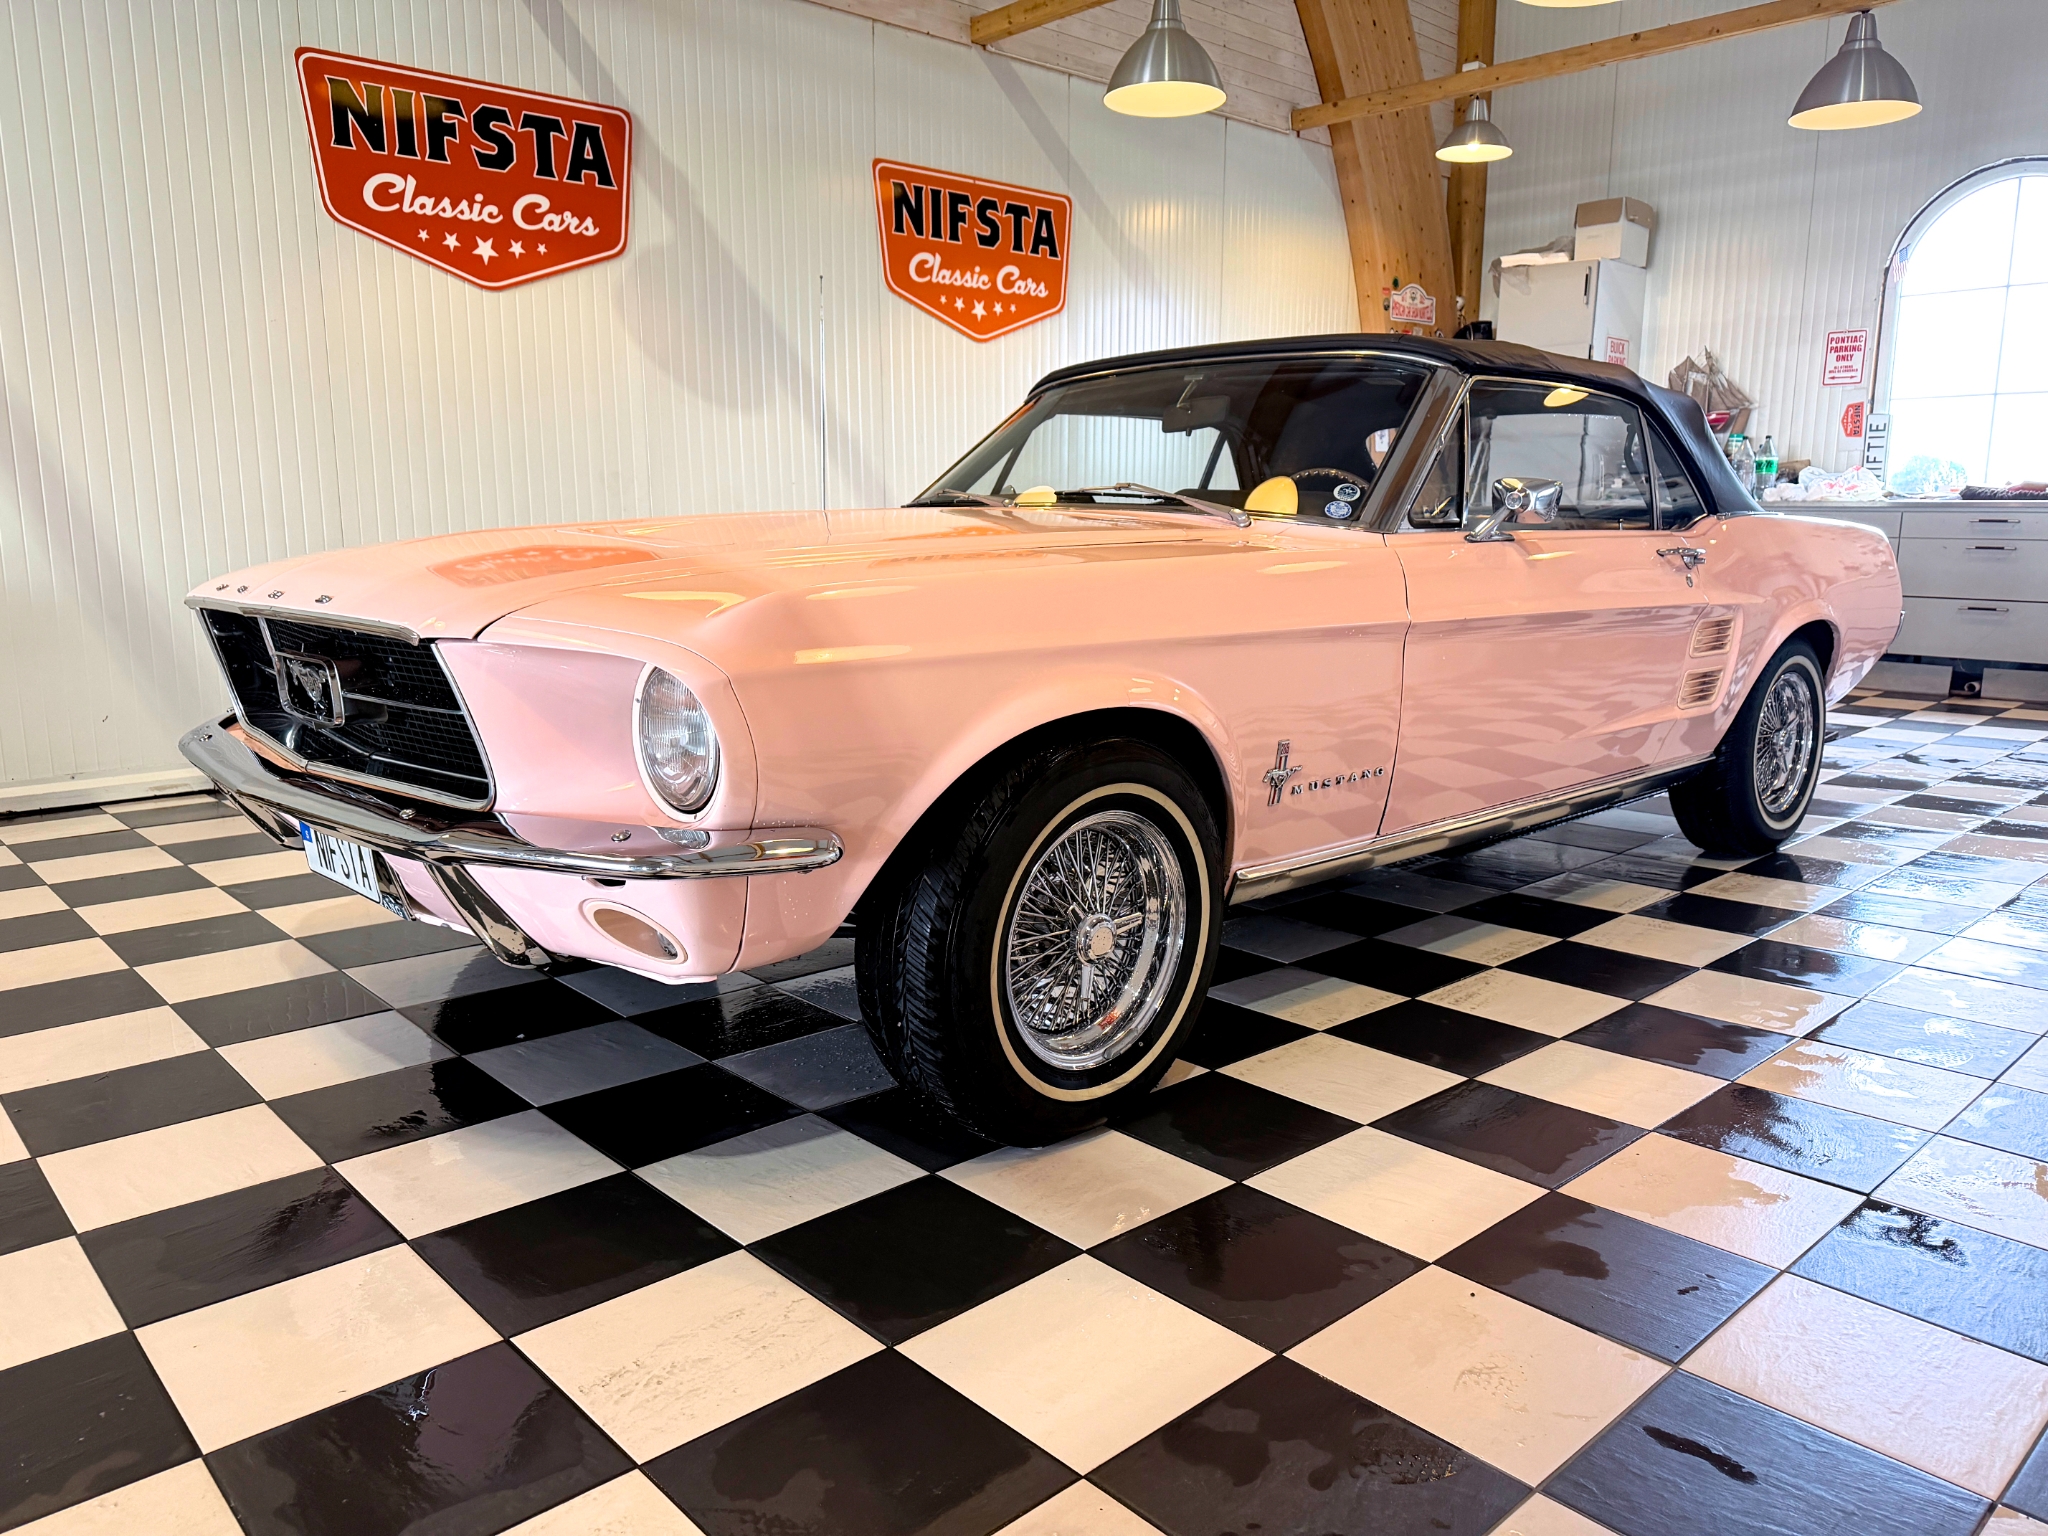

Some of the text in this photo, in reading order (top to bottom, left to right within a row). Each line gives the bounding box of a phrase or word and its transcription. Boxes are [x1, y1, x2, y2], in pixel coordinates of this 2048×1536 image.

[325, 75, 618, 190] NIFSTA
[362, 172, 600, 237] Classic Cars
[890, 179, 1061, 260] NIFSTA
[908, 251, 1049, 298] Classic Cars
[1610, 340, 1626, 355] BUICK
[1829, 344, 1862, 354] PARKING
[1830, 335, 1864, 345] PONTIAC
[1835, 353, 1854, 362] ONLY
[1853, 404, 1861, 436] NIFSTA
[1866, 422, 1887, 481] IFTIE
[1290, 766, 1384, 795] MUSTANG
